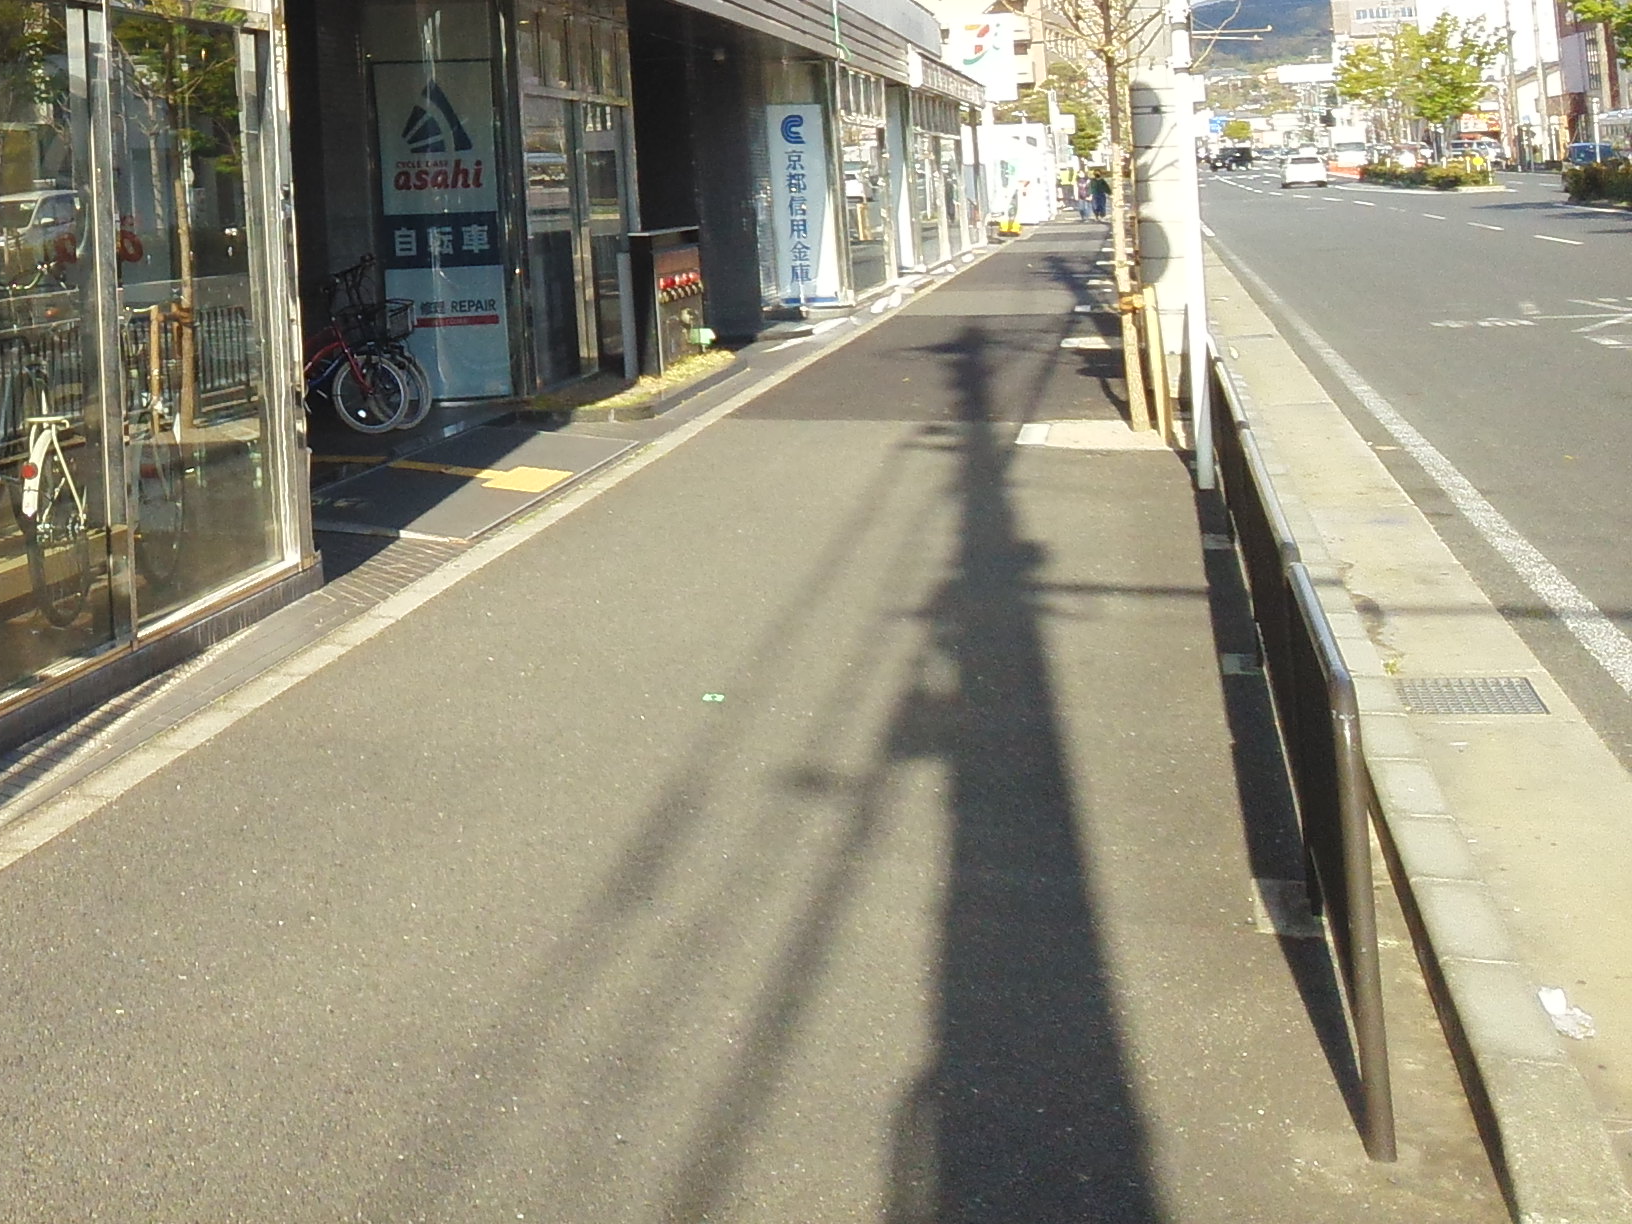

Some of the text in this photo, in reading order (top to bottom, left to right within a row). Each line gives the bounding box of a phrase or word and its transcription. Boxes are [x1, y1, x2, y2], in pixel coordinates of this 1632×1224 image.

[393, 158, 484, 191] asahi
[784, 149, 812, 284] 京都信用金庫
[393, 223, 491, 257] 自転車
[450, 298, 497, 313] REPAIR
